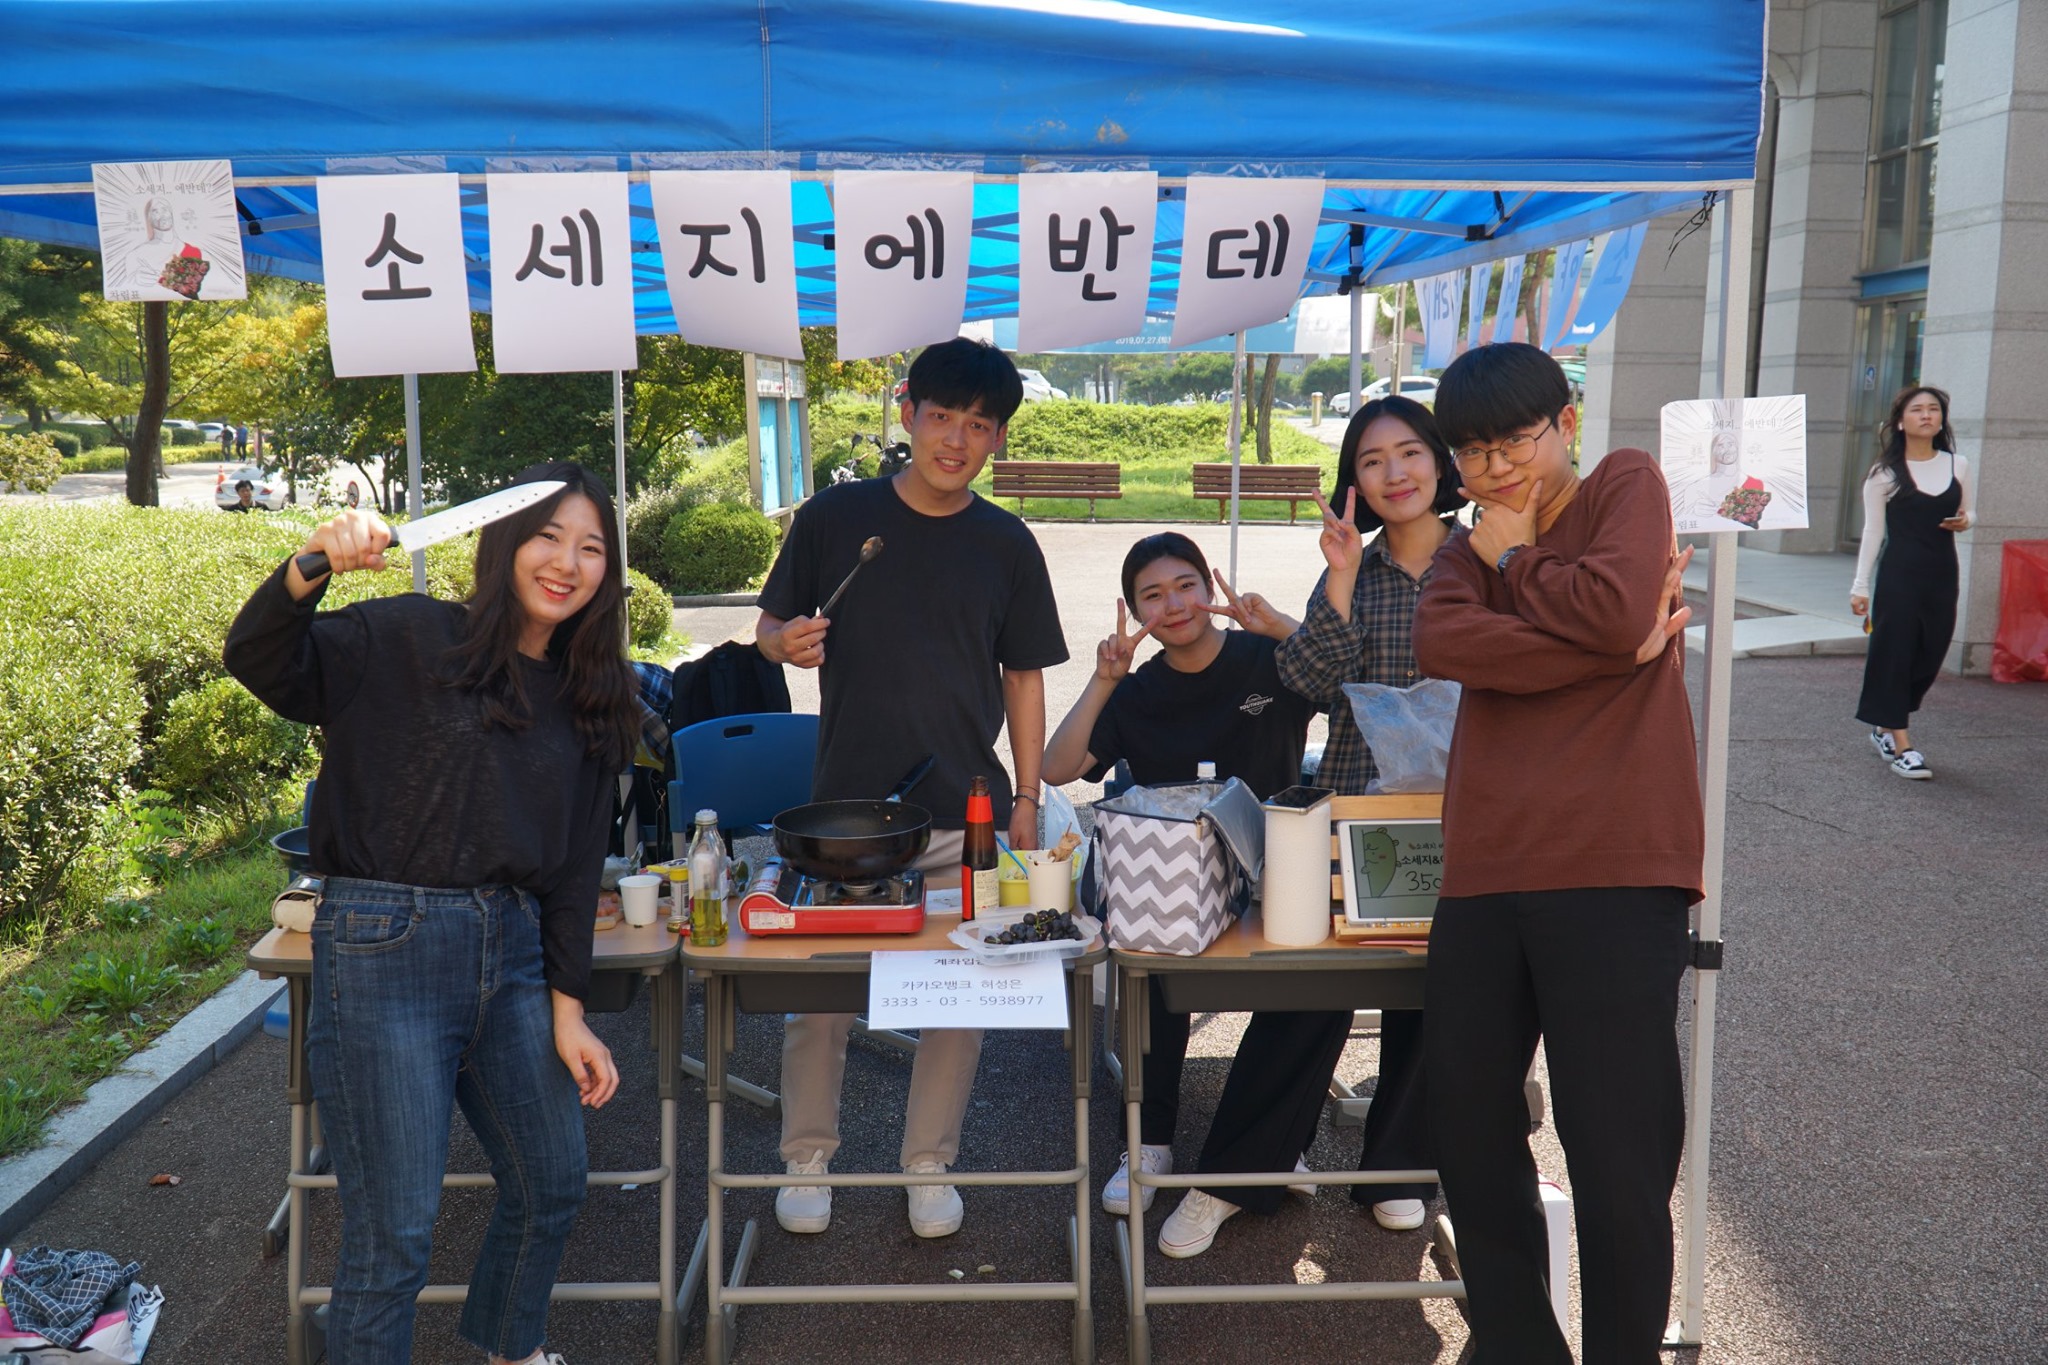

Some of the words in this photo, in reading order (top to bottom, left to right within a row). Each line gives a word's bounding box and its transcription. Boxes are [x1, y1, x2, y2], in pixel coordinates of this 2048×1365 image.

[901, 979, 972, 991] 카카오뱅크
[980, 978, 1024, 991] 허성은
[881, 996, 918, 1007] 3333
[939, 996, 958, 1007] 03
[979, 995, 1044, 1006] 5938977
